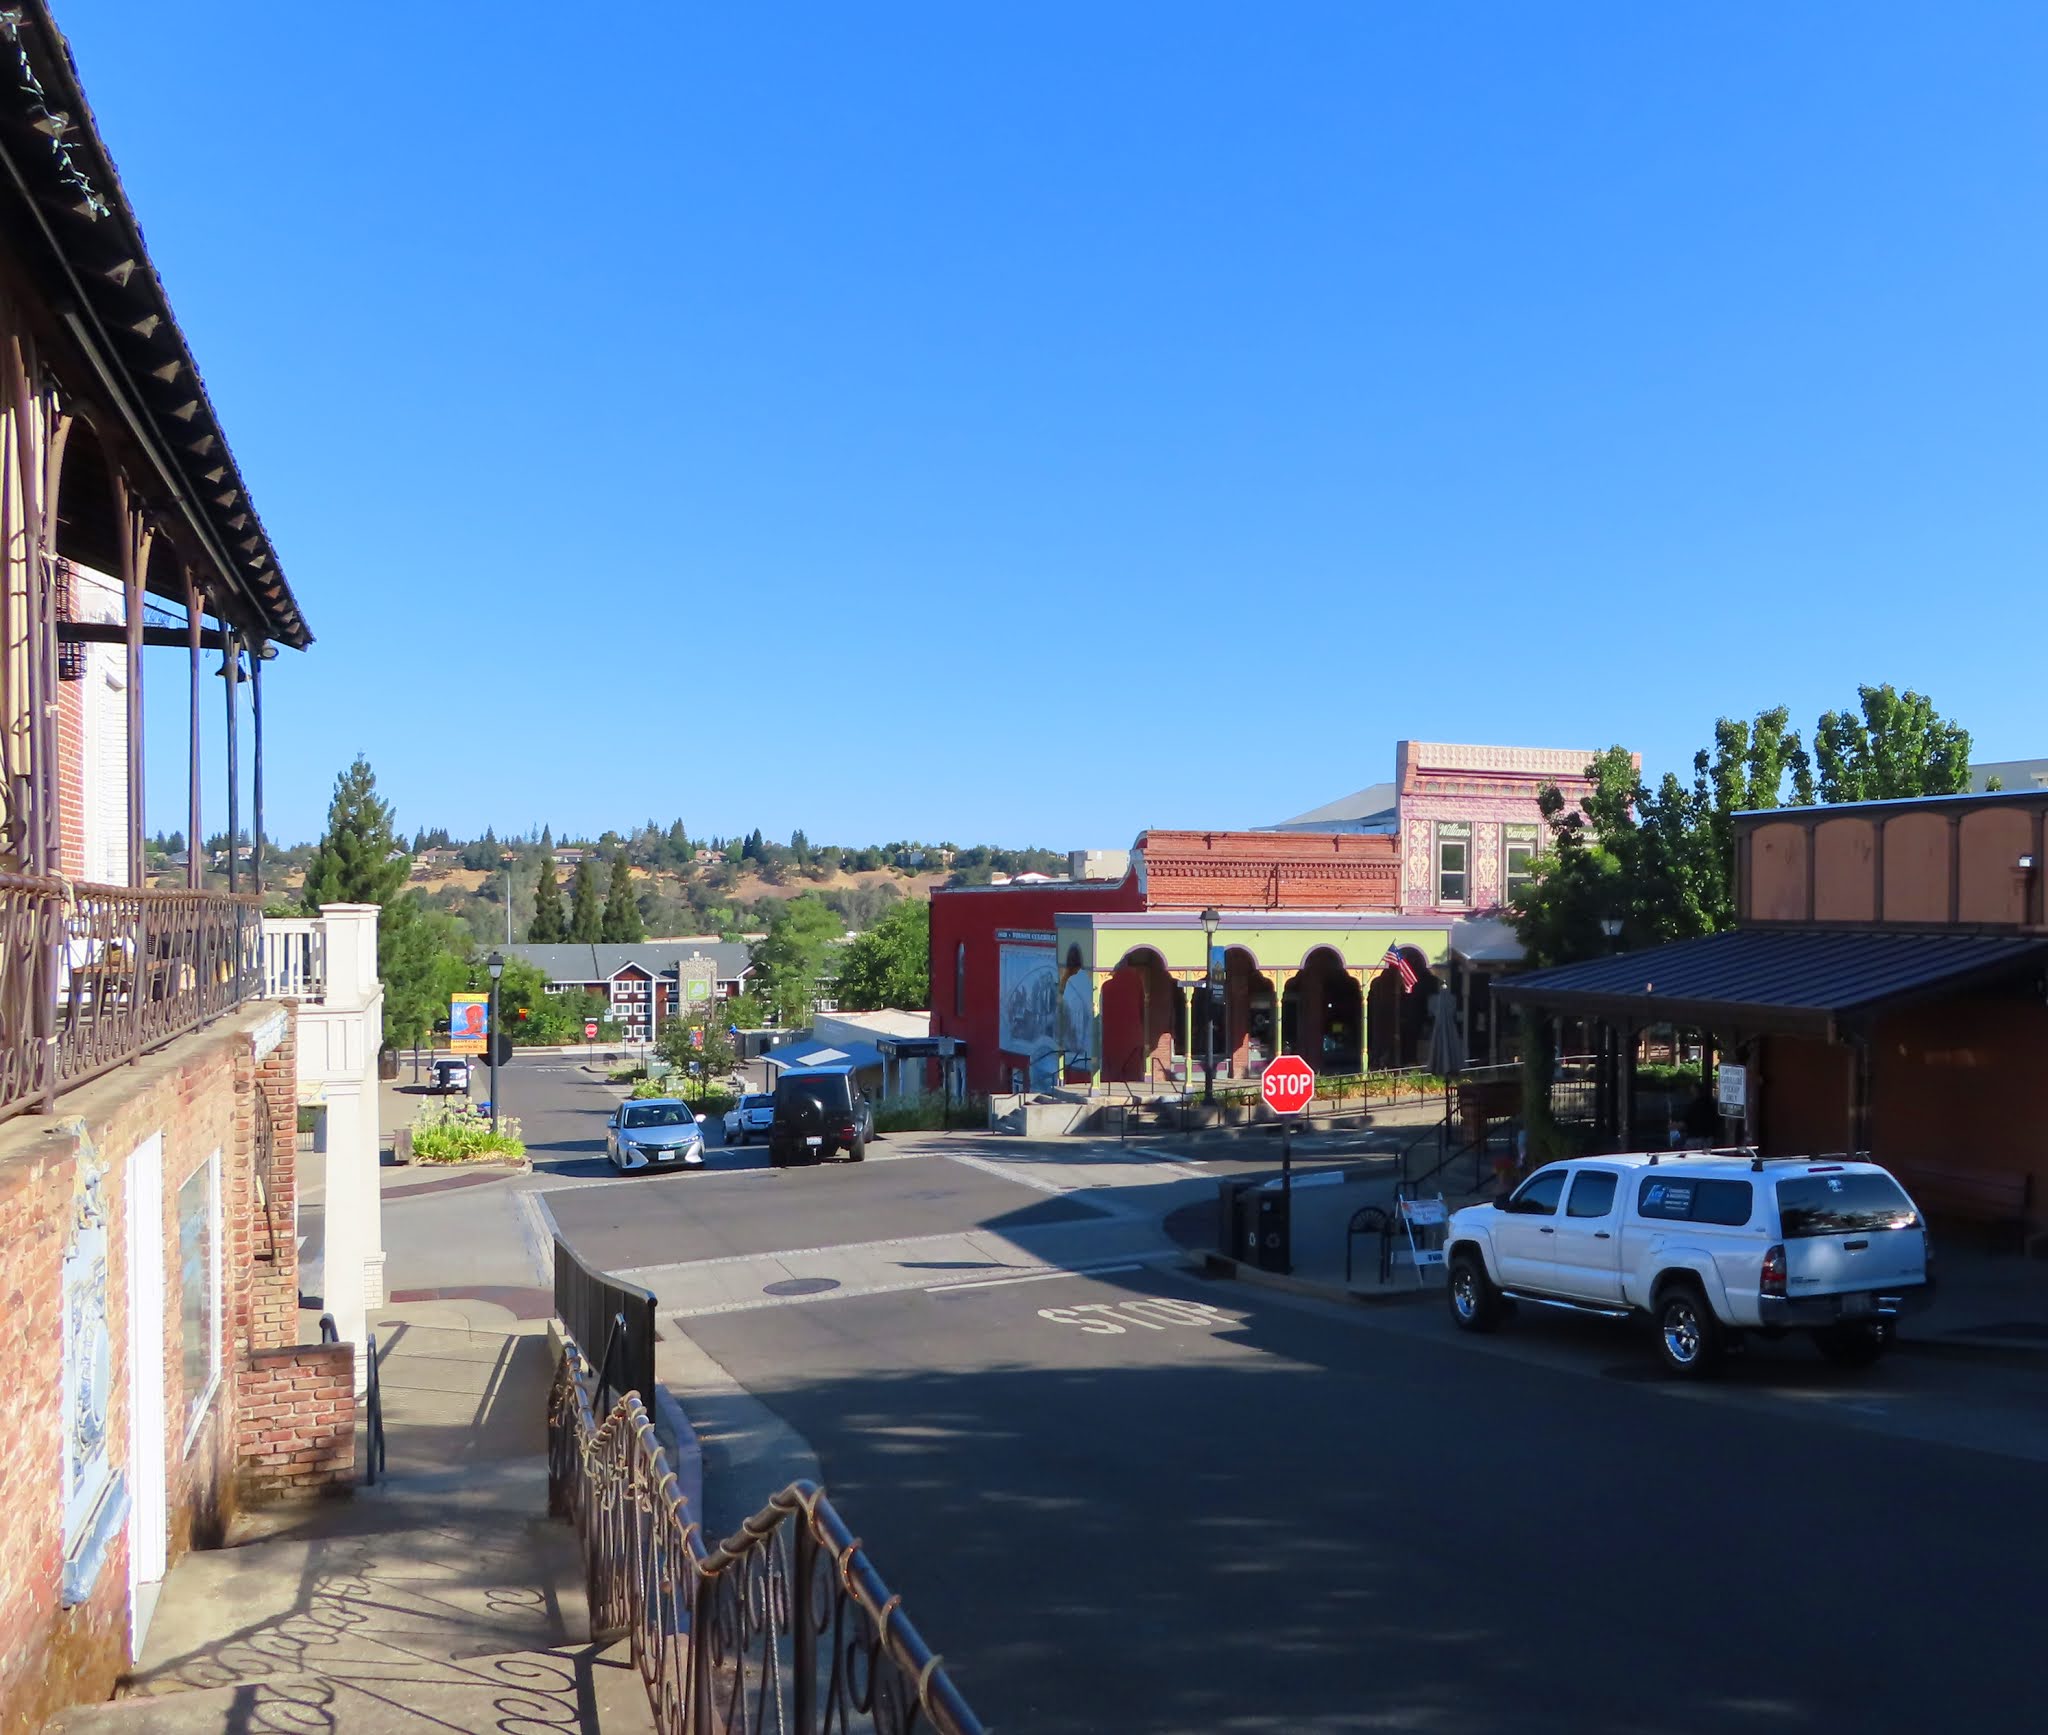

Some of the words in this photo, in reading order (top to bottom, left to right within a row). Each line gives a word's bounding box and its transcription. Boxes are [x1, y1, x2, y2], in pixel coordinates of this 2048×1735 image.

[1438, 823, 1471, 837] Williams
[1506, 826, 1538, 841] Carriage
[1265, 1074, 1311, 1096] STOP
[1037, 1298, 1238, 1335] STOP
